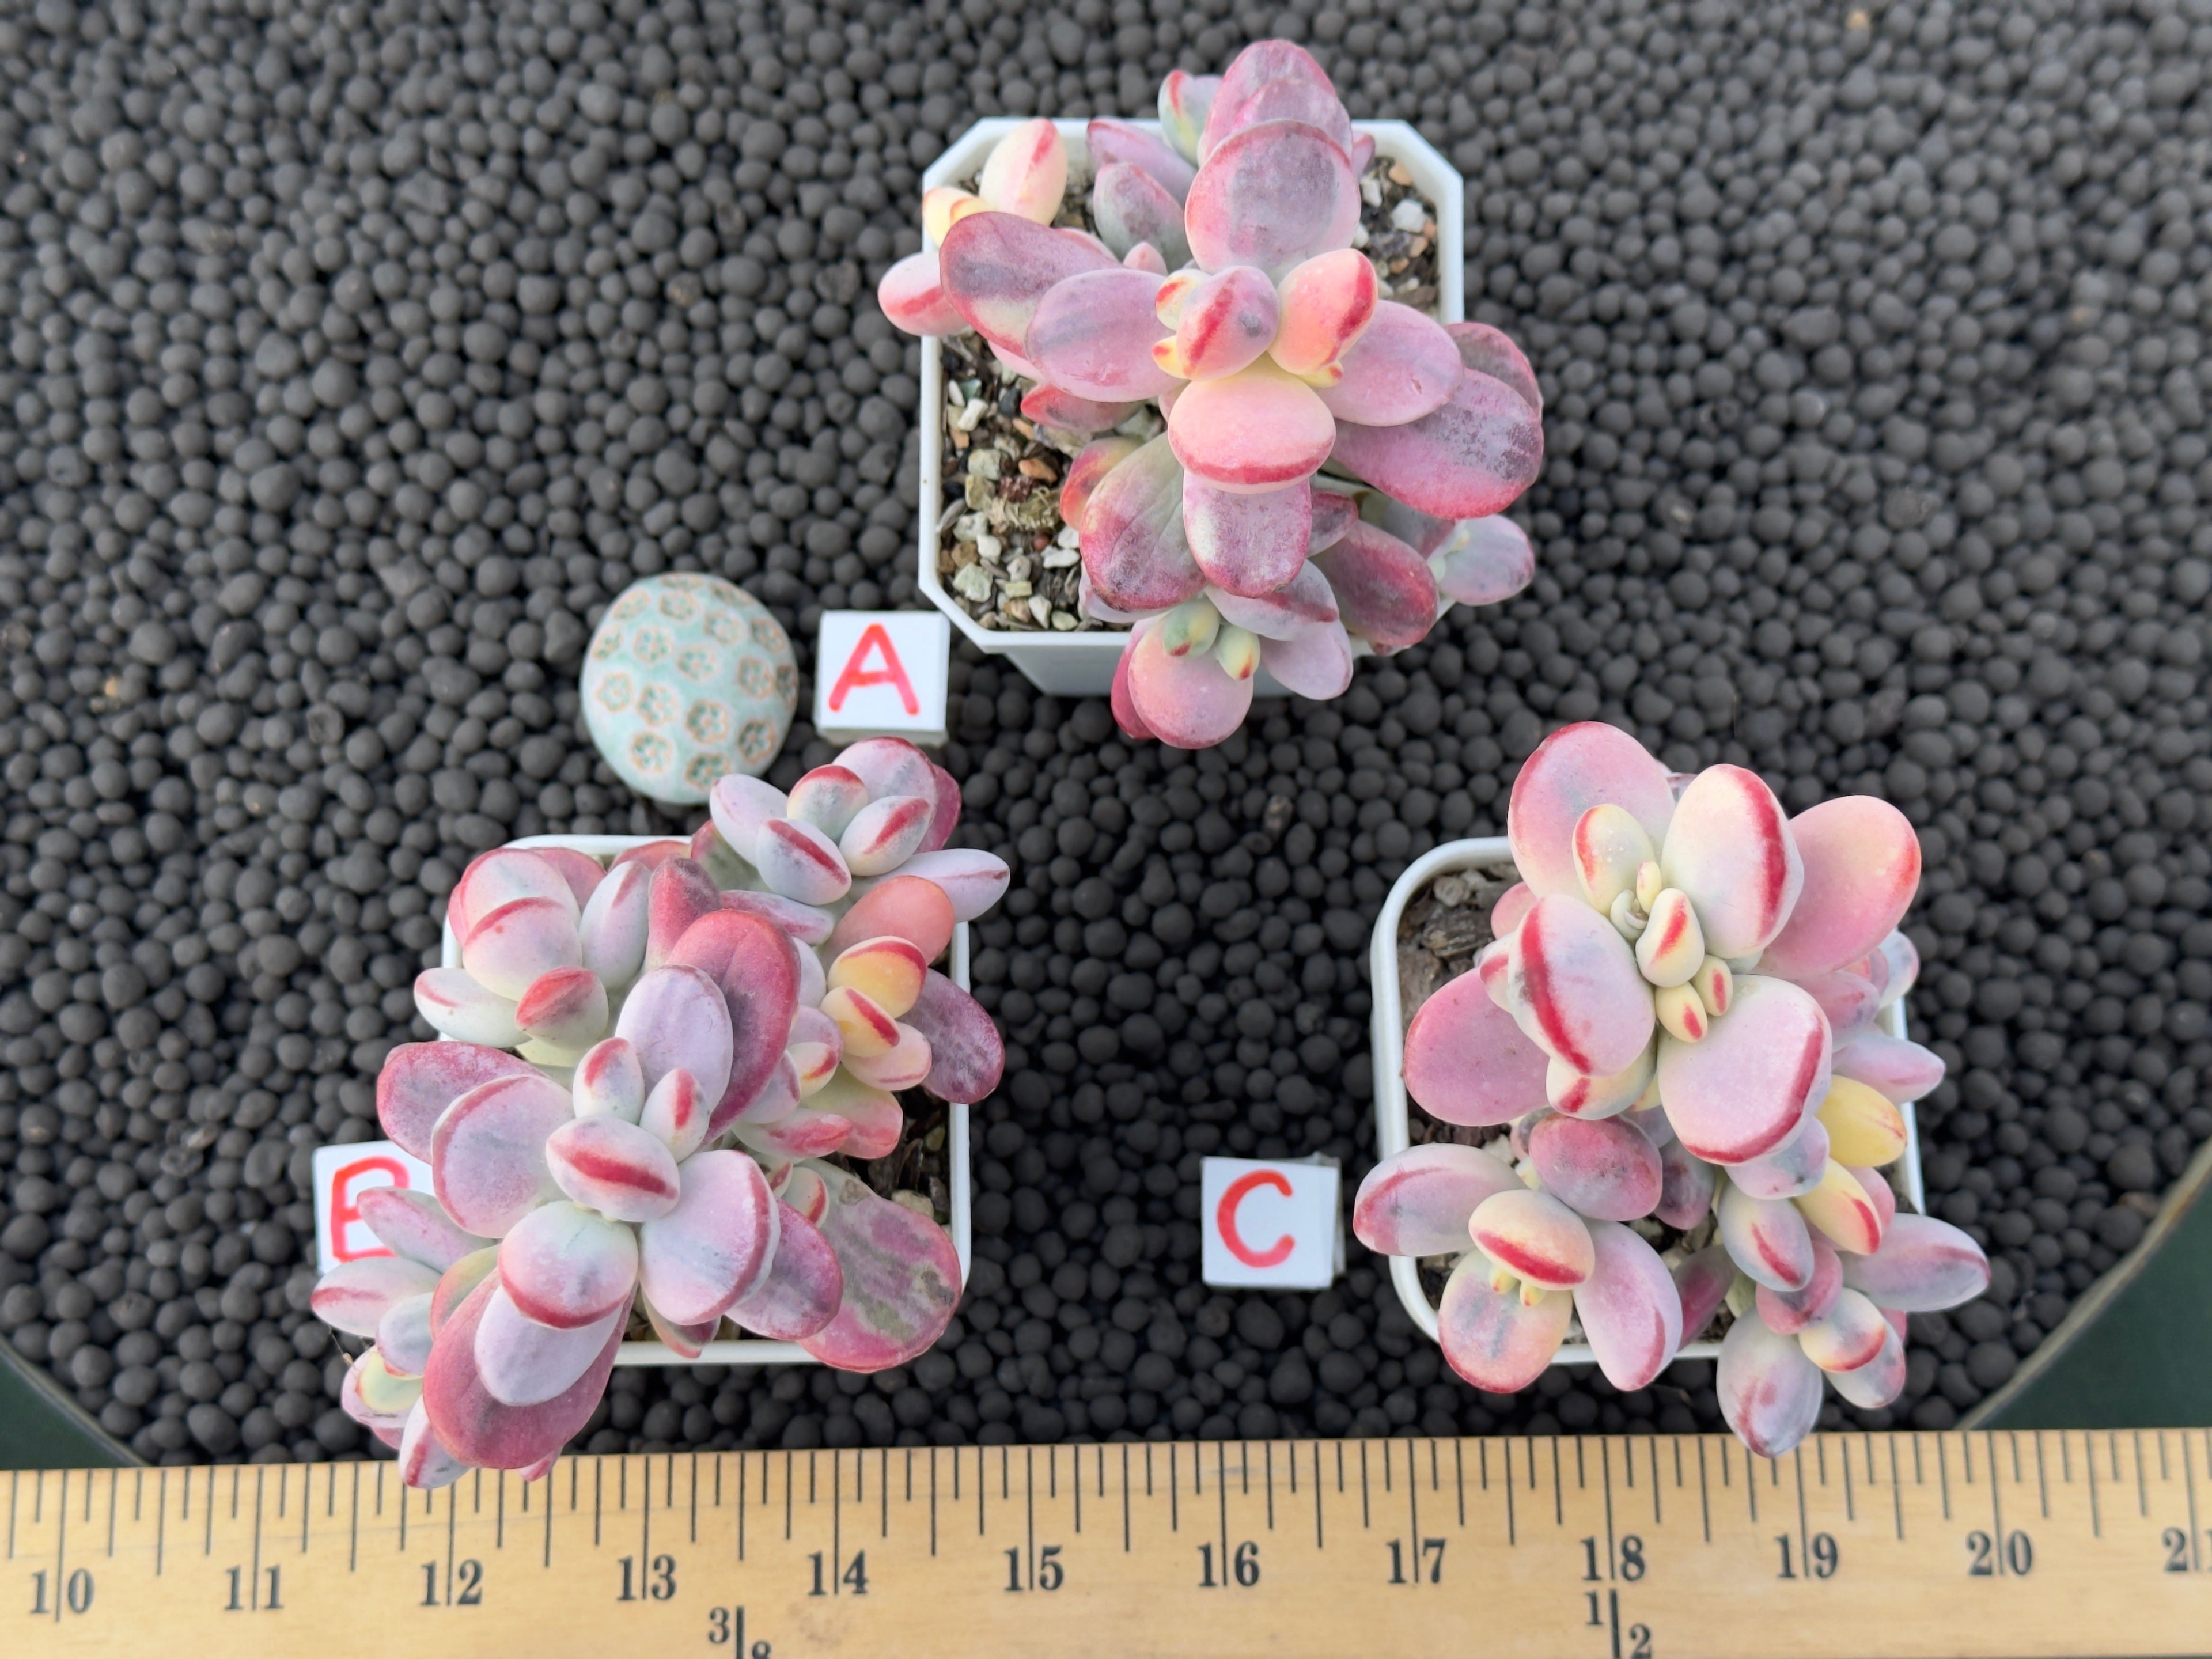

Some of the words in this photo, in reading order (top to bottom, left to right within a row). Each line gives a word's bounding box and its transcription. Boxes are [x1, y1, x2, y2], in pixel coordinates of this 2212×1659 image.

[829, 623, 919, 716] A
[1217, 1169, 1296, 1268] C
[29, 1568, 94, 1615] 10
[224, 1565, 284, 1611] 11
[421, 1559, 483, 1606] 12
[617, 1554, 676, 1601] 13
[807, 1550, 869, 1596] 14
[1004, 1546, 1064, 1592] 15
[1198, 1542, 1260, 1588] 16
[1387, 1538, 1447, 1584] 17
[1582, 1535, 1646, 1581] 18
[1776, 1532, 1839, 1578] 19
[1966, 1529, 2033, 1575] 20
